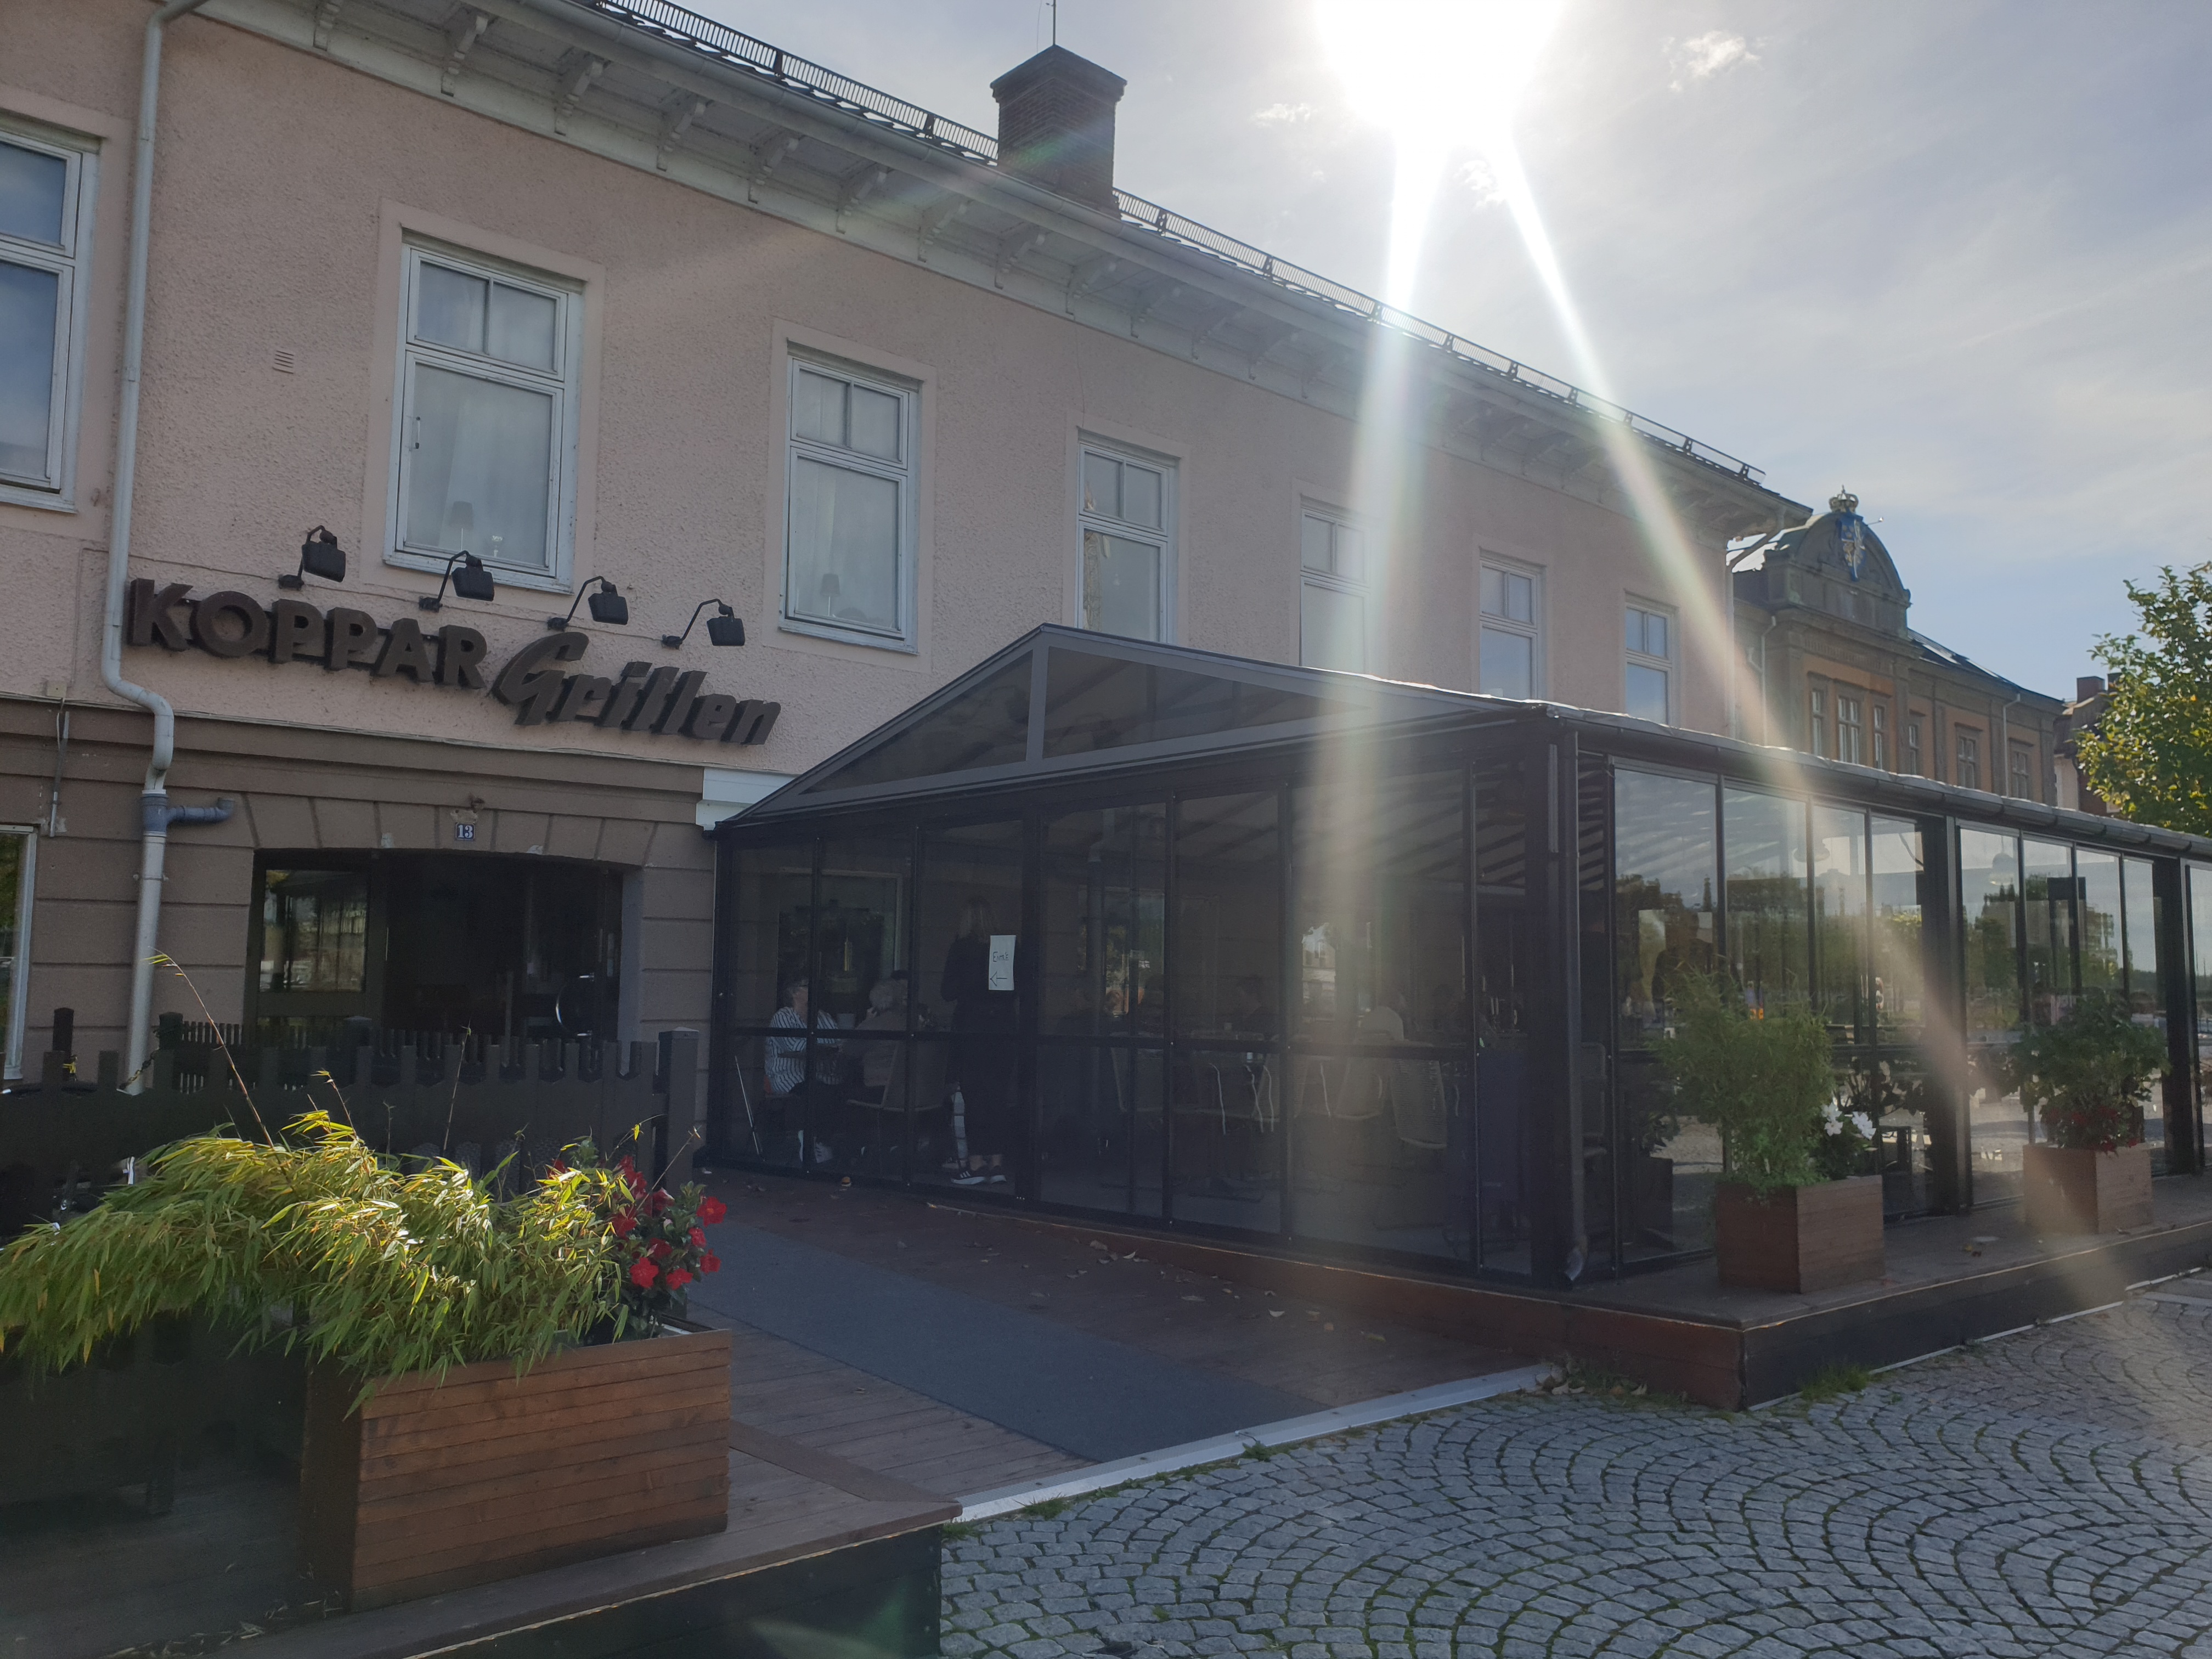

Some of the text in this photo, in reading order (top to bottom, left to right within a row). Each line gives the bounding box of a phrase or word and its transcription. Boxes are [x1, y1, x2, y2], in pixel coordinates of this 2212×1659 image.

[128, 578, 781, 745] KOPPAR Grillen
[458, 824, 473, 839] 13
